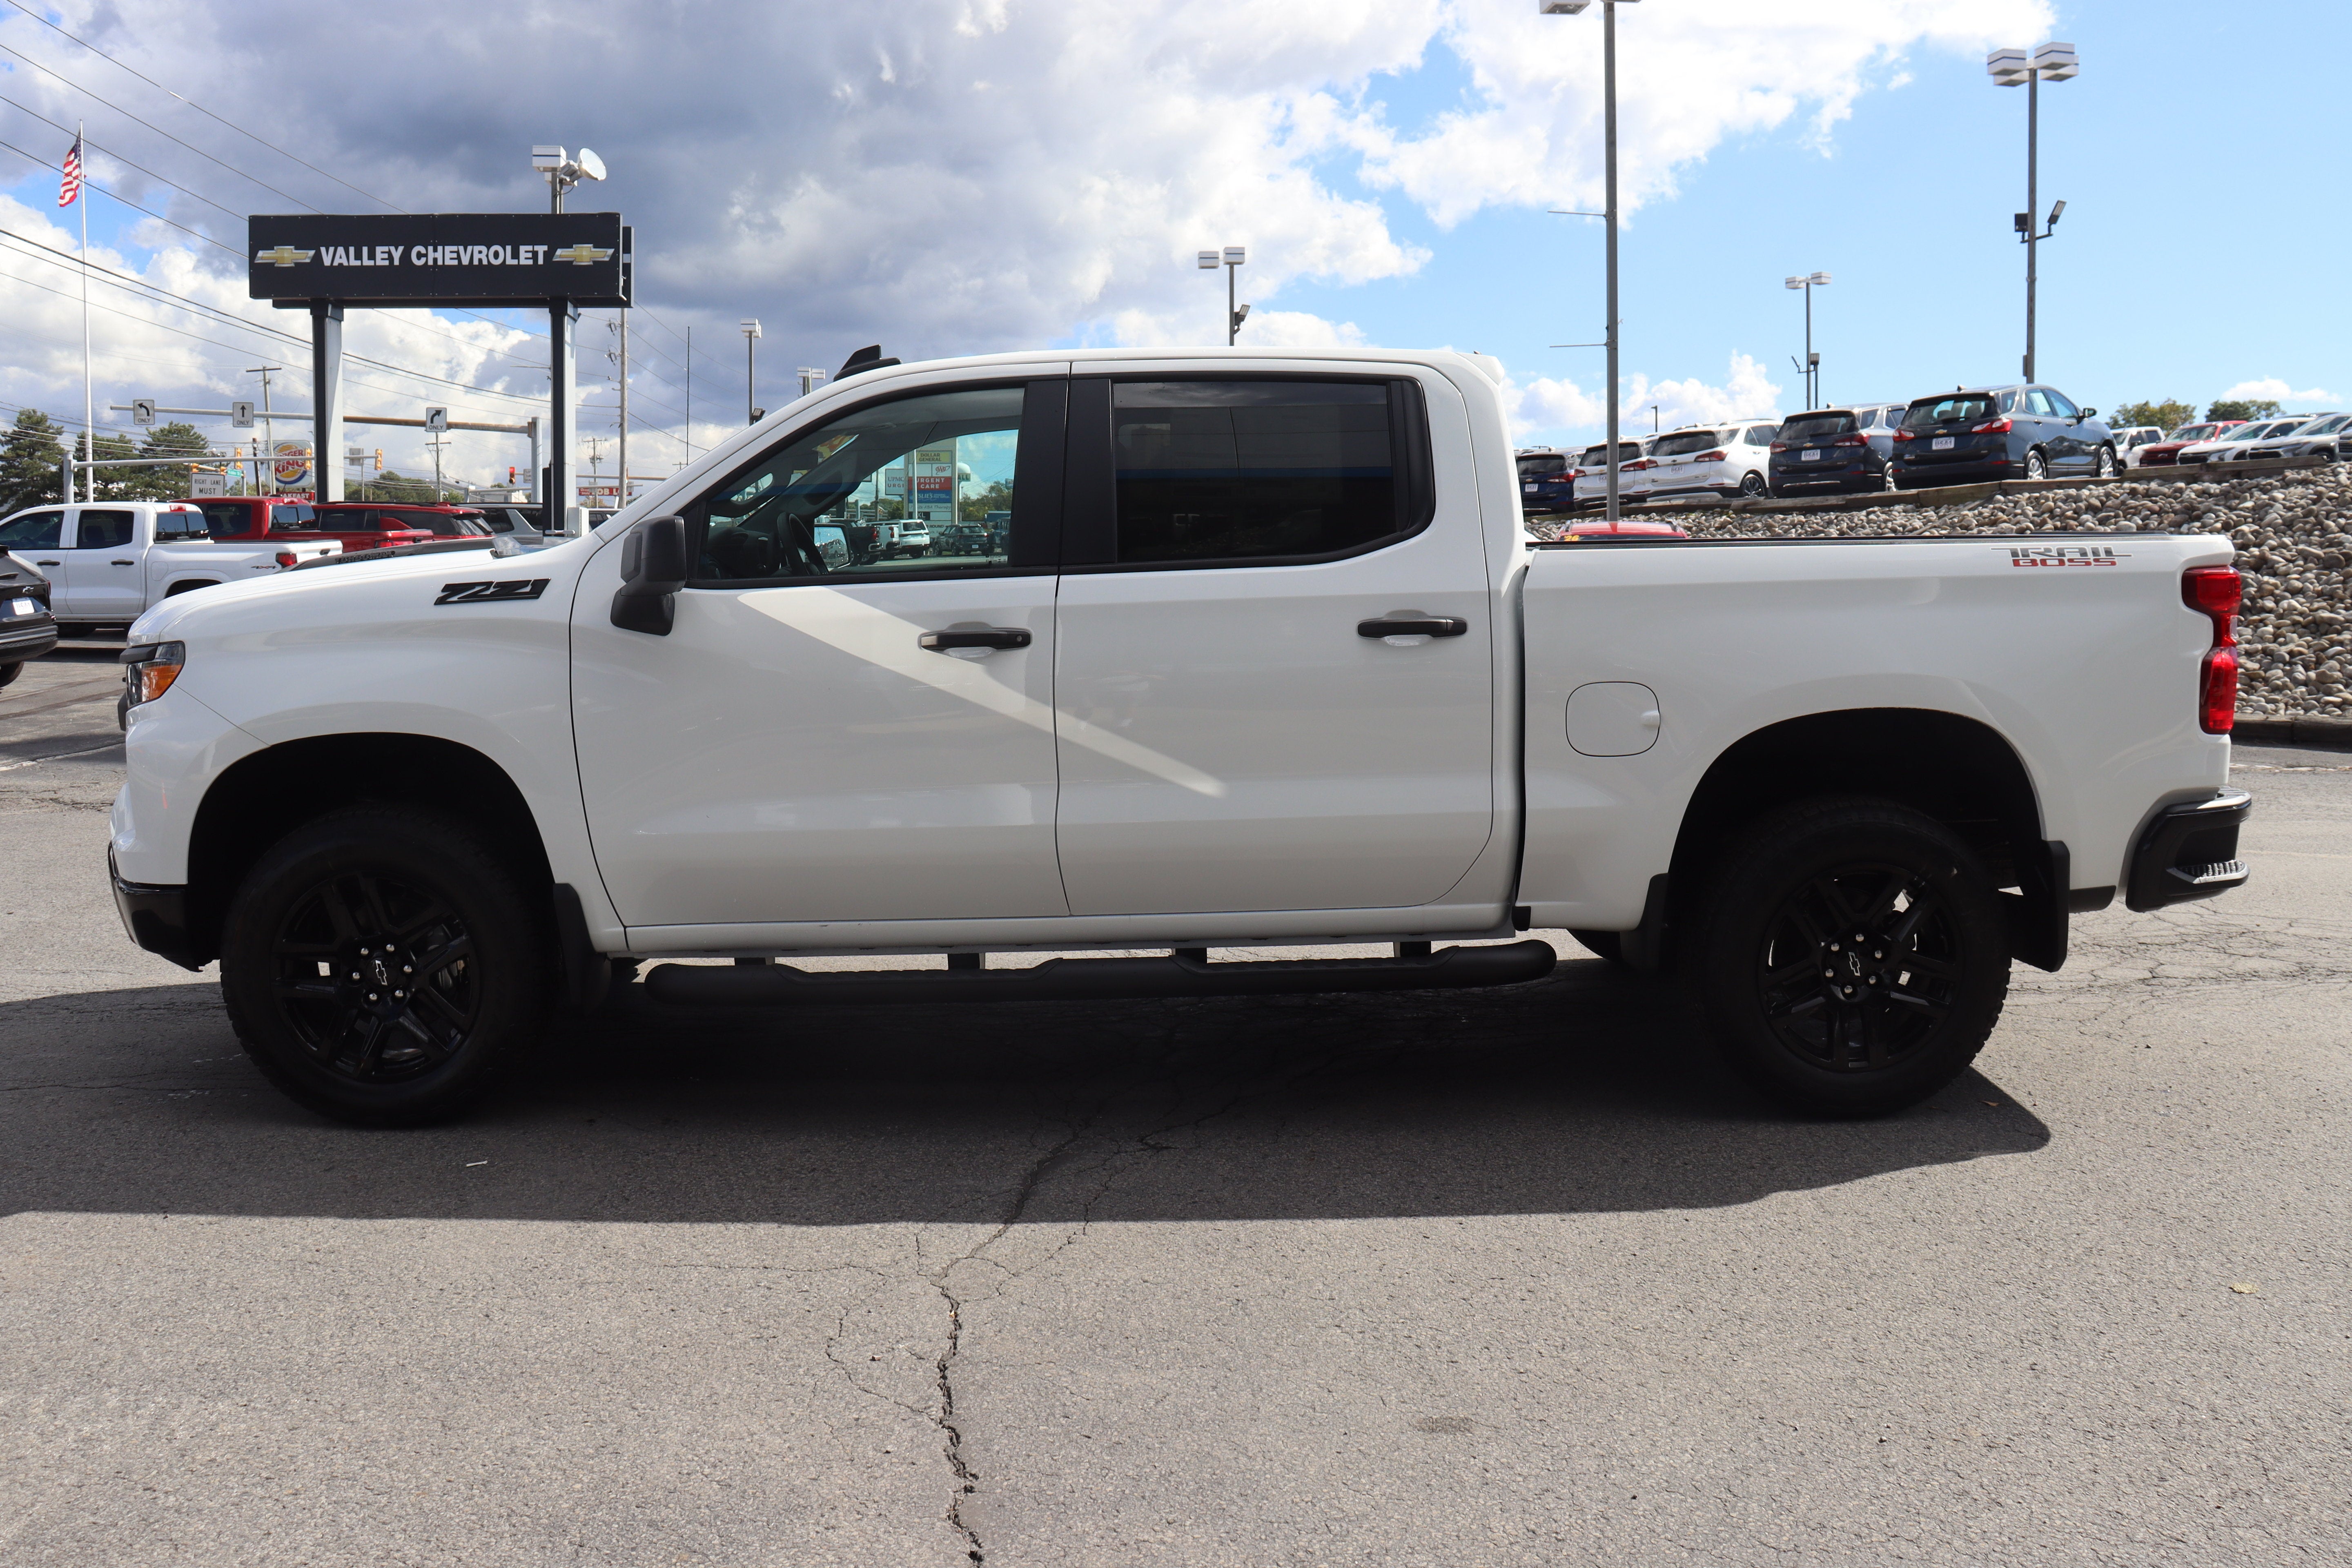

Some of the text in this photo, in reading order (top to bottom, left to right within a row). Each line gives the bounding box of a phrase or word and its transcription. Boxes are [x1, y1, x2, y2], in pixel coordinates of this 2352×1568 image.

[320, 245, 548, 266] VALLEY CHEVROLET
[1990, 546, 2133, 558] TRAIL
[2012, 557, 2117, 567] BOSS
